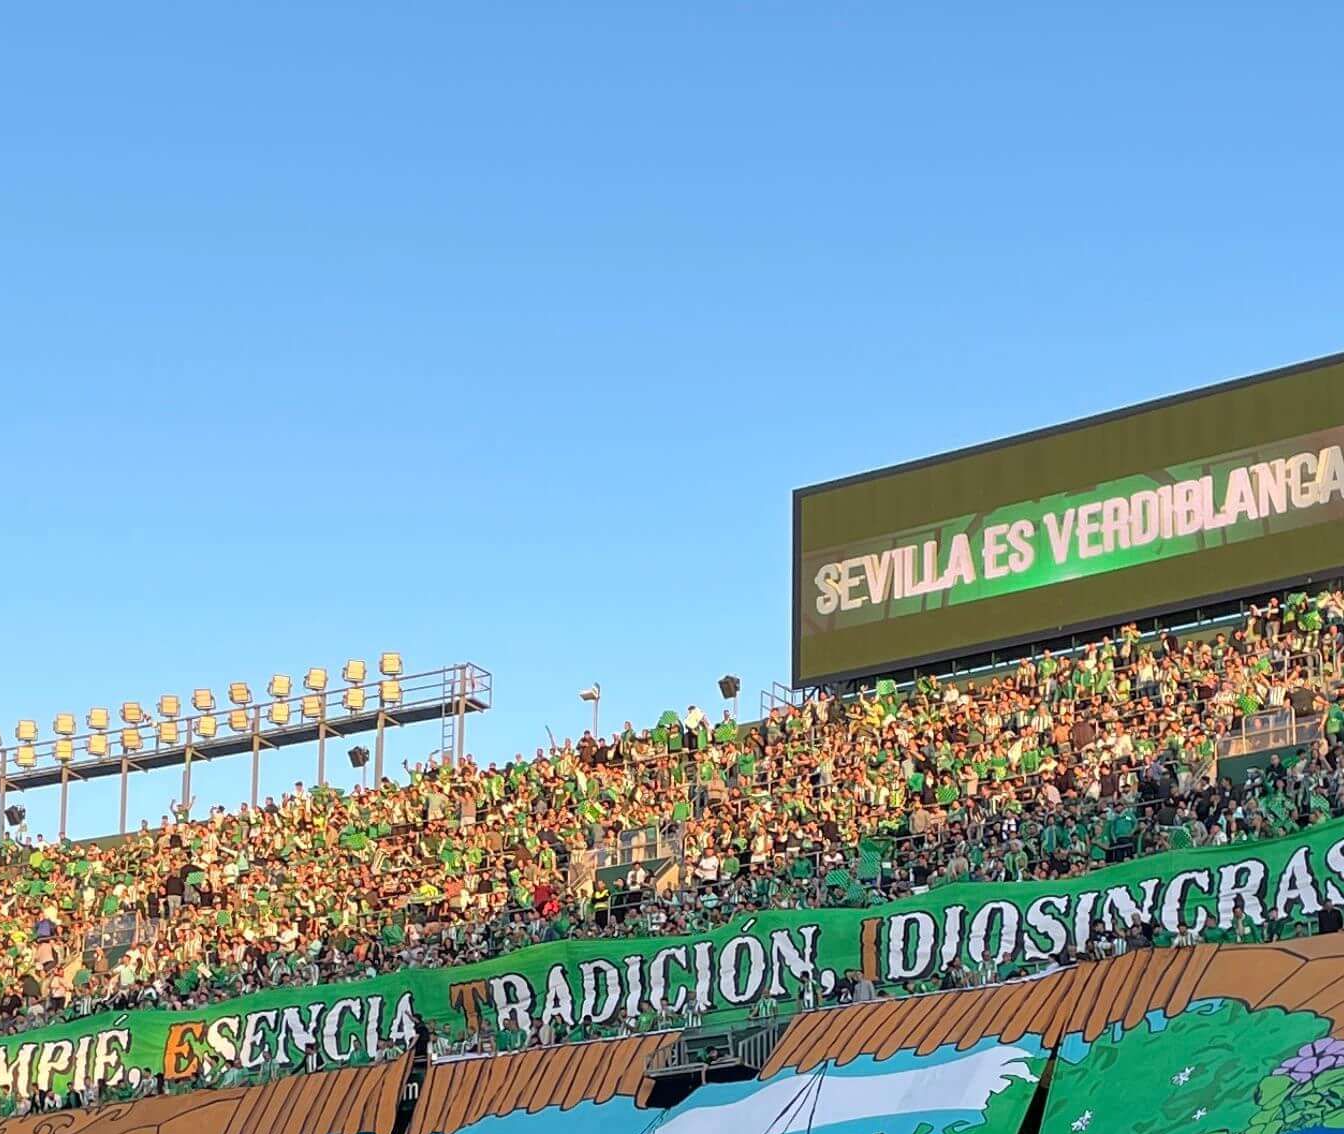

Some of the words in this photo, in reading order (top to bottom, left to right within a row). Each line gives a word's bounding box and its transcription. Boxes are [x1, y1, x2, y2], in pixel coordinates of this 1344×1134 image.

[814, 533, 977, 616] SEVILLA
[982, 519, 1035, 580] ES
[163, 991, 417, 1081] ESENCIA
[450, 918, 836, 1037] TRADICIÓN,
